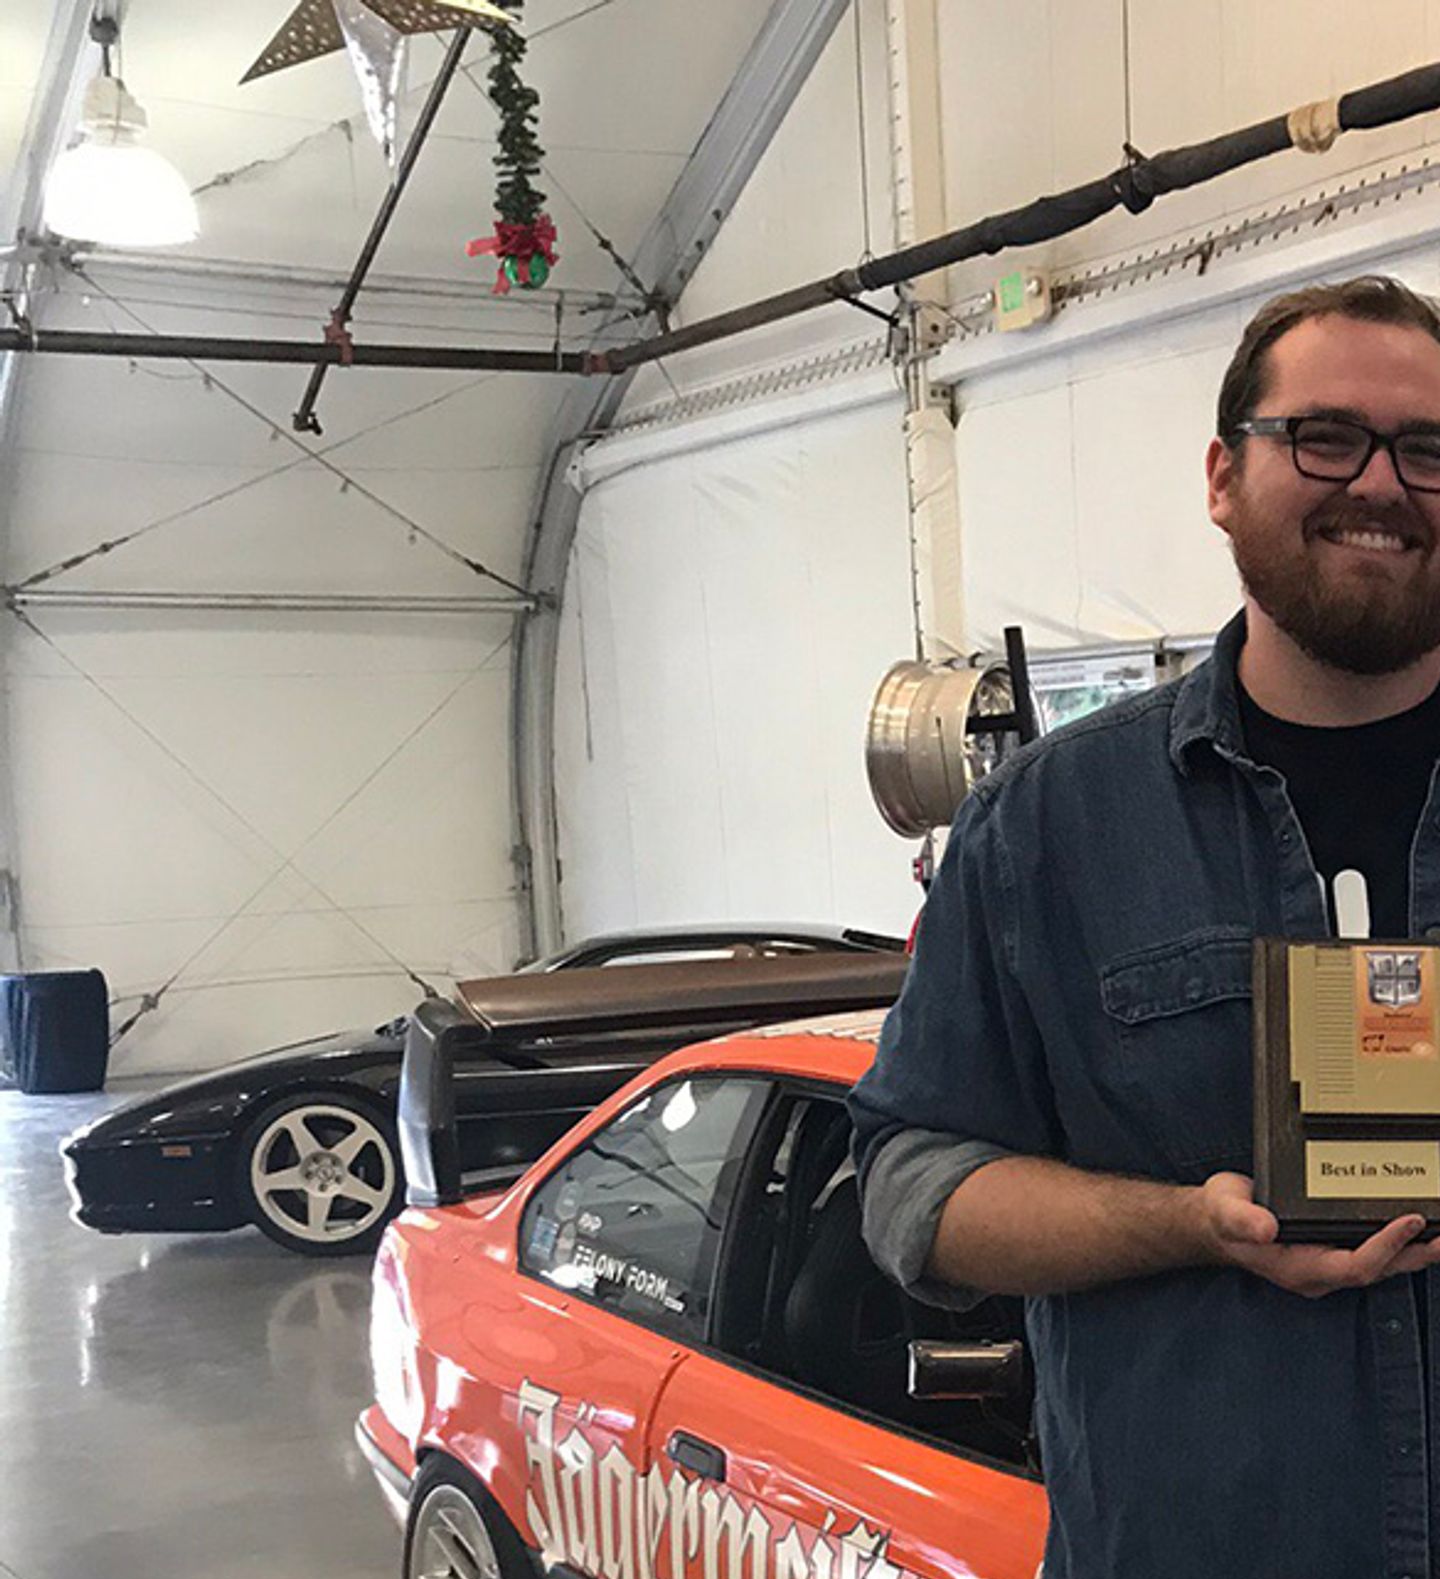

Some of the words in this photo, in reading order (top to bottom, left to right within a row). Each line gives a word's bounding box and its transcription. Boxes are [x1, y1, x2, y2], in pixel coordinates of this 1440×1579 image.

[1321, 1162, 1355, 1176] Best
[1361, 1162, 1377, 1176] in
[1382, 1162, 1427, 1176] Show
[573, 1244, 627, 1285] FELONY
[626, 1265, 669, 1301] FORM
